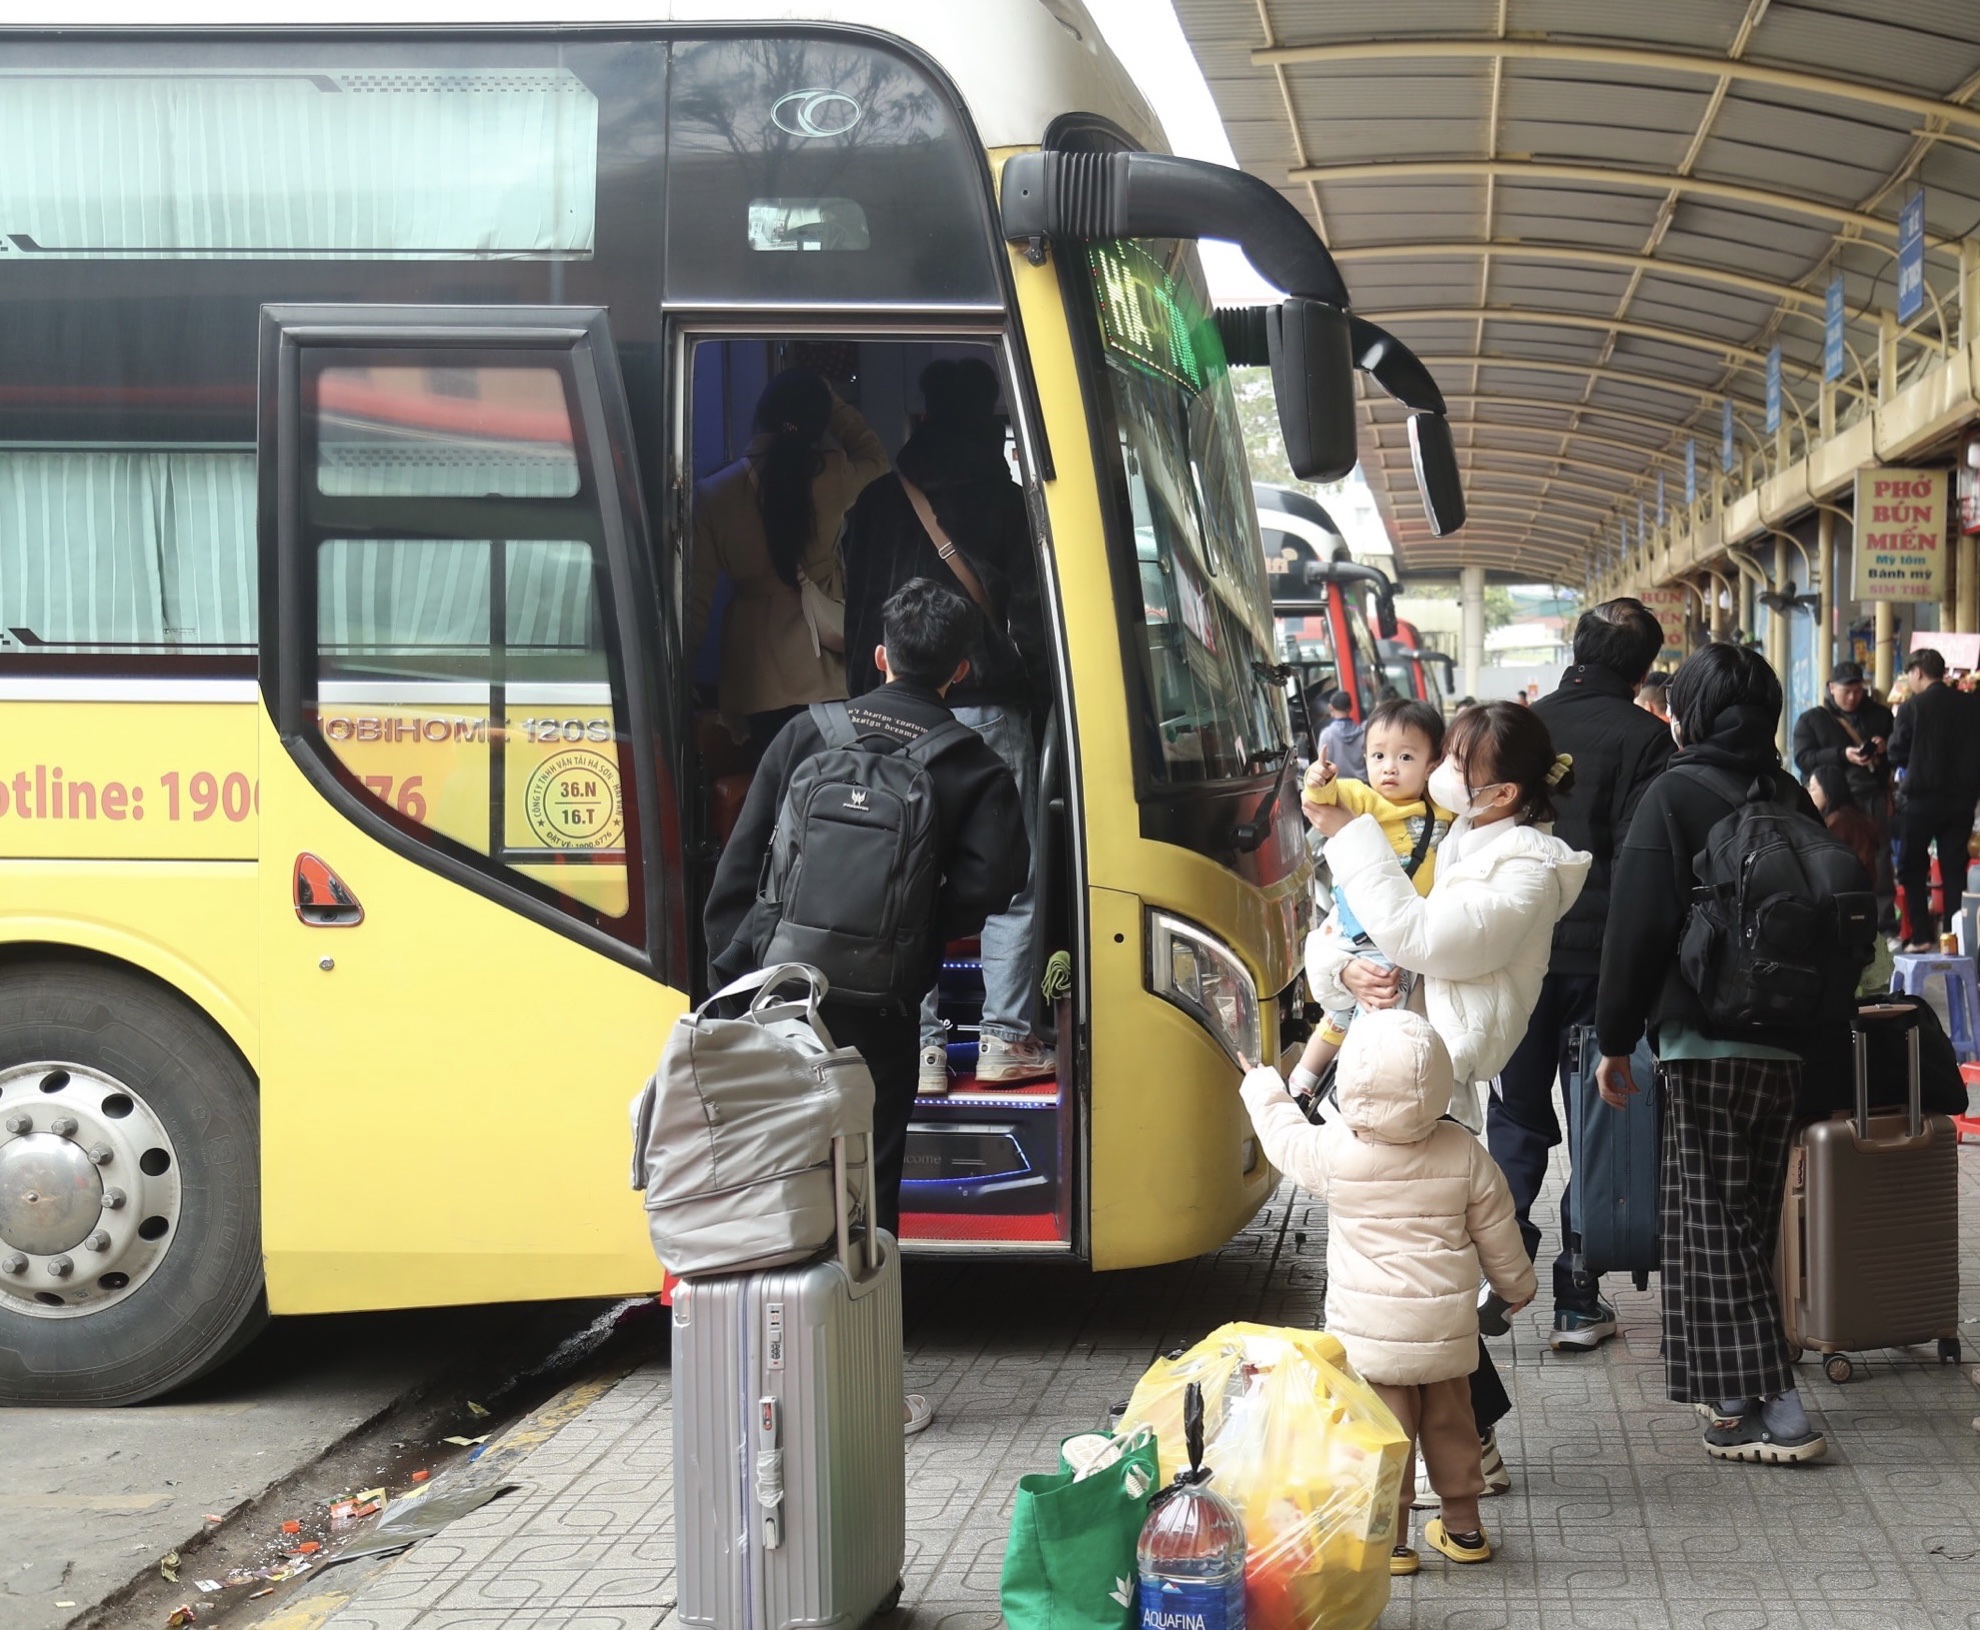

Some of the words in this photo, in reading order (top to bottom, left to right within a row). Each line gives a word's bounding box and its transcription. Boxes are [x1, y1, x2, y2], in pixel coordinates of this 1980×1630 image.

[1873, 473, 1932, 498] PHỞ
[1872, 500, 1932, 523] BÚN
[1866, 525, 1937, 550] MIẾN
[317, 716, 510, 743] OBIHOM
[521, 718, 617, 743] 120S
[160, 771, 259, 822] 190
[353, 775, 427, 823] 76
[560, 781, 596, 798] 36.N
[562, 808, 595, 825] 16.T
[1143, 1608, 1206, 1630] AQUAFINA
